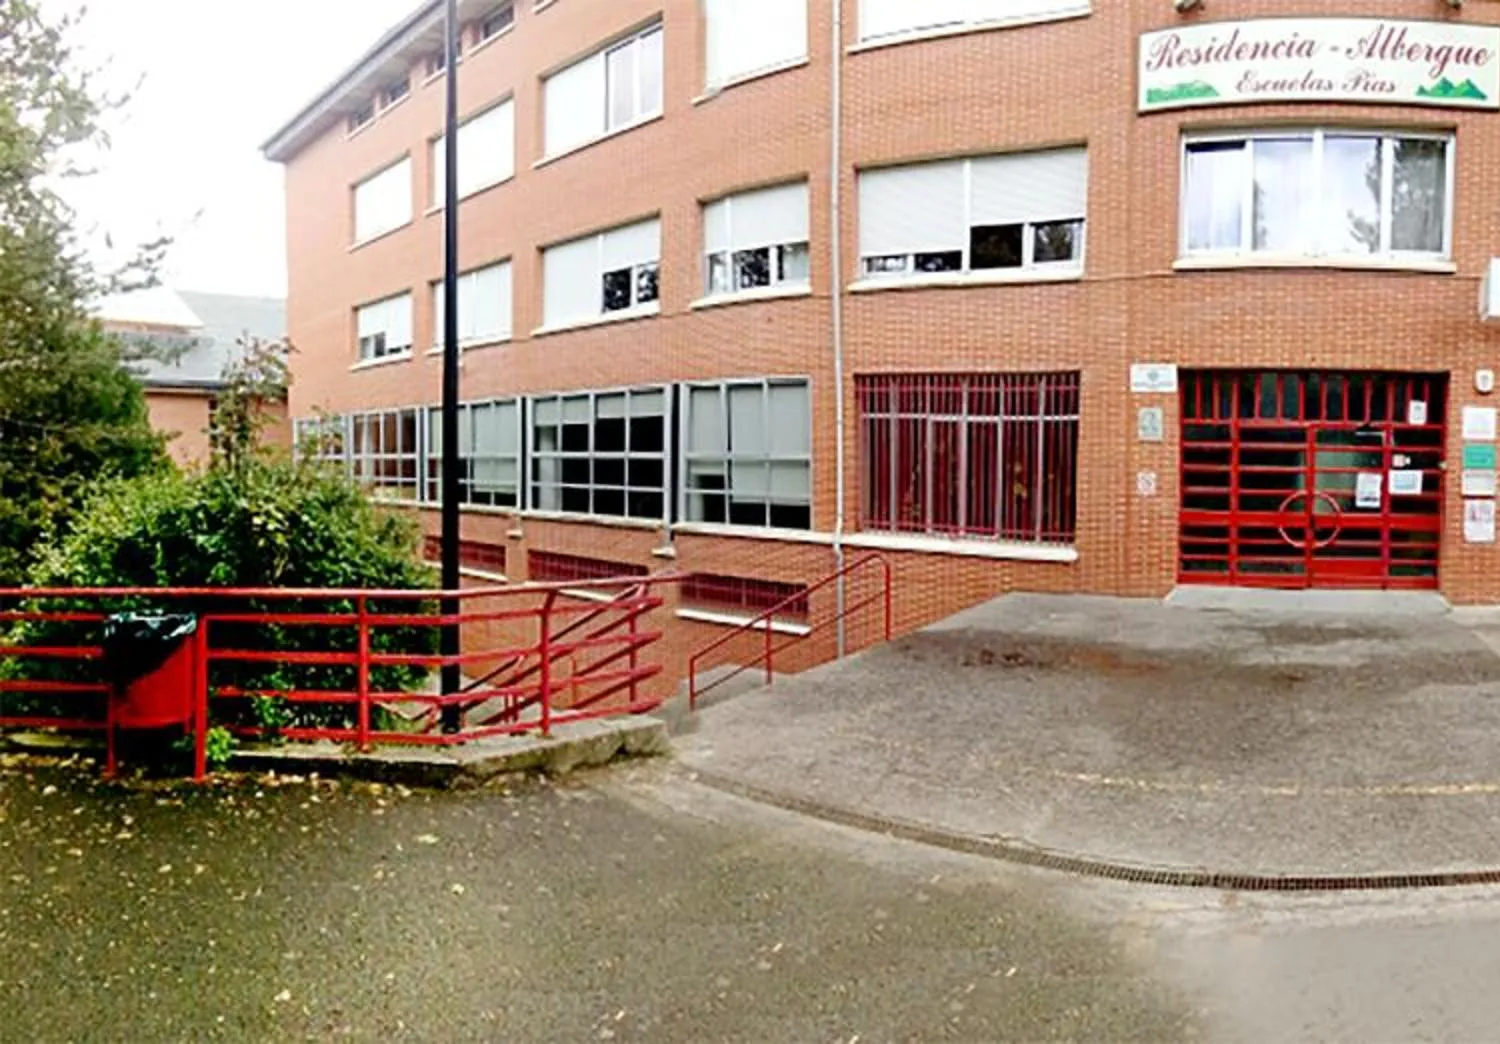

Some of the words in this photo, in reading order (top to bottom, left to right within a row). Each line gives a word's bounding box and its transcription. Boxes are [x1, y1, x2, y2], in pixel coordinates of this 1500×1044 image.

[1146, 28, 1317, 71] Residencia
[1345, 24, 1493, 78] Albergue
[1235, 69, 1333, 93] Escuelas
